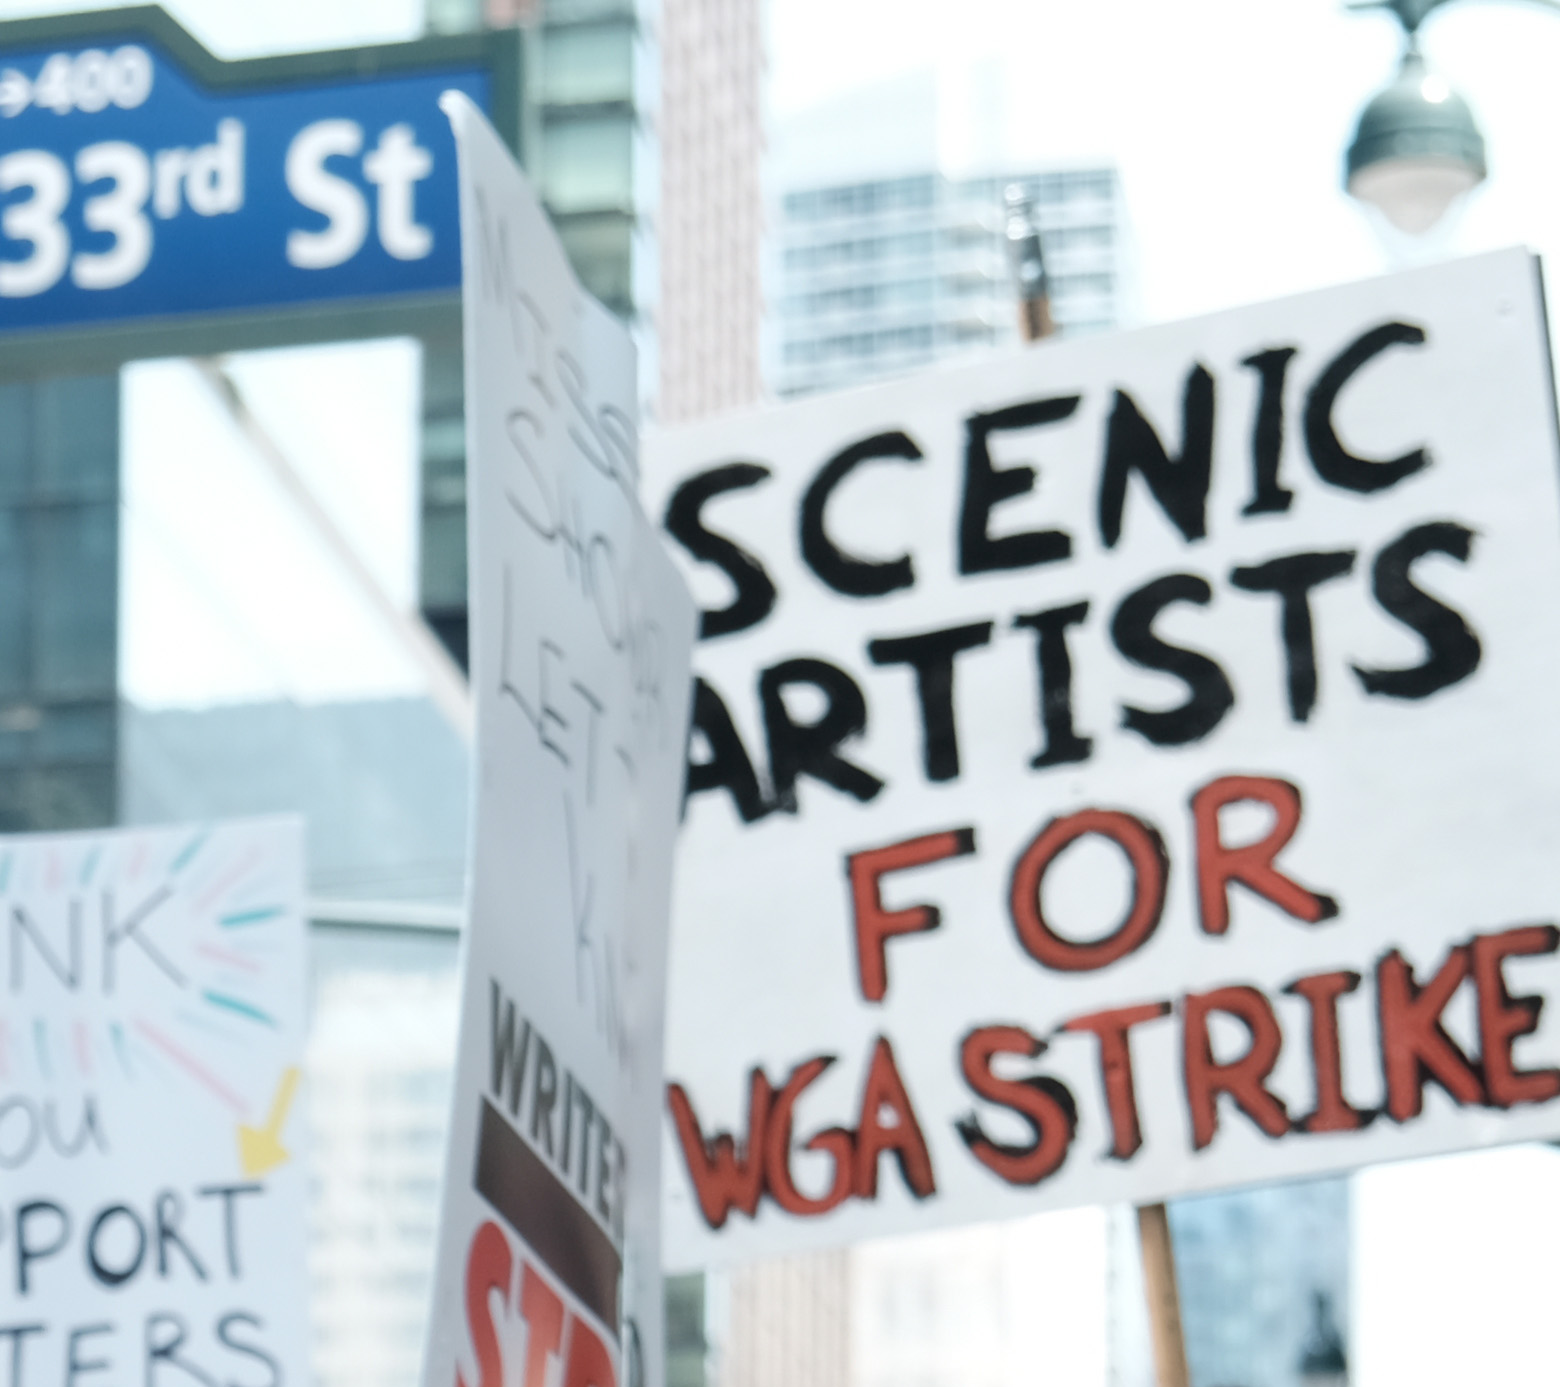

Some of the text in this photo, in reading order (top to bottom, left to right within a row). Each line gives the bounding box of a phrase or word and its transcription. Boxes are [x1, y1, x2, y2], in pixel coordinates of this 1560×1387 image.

[33, 44, 155, 117] 400
[284, 117, 436, 270] St
[661, 321, 1434, 645] SCENIC
[680, 520, 1486, 826] ARTISTS
[844, 773, 1340, 1004] FOR
